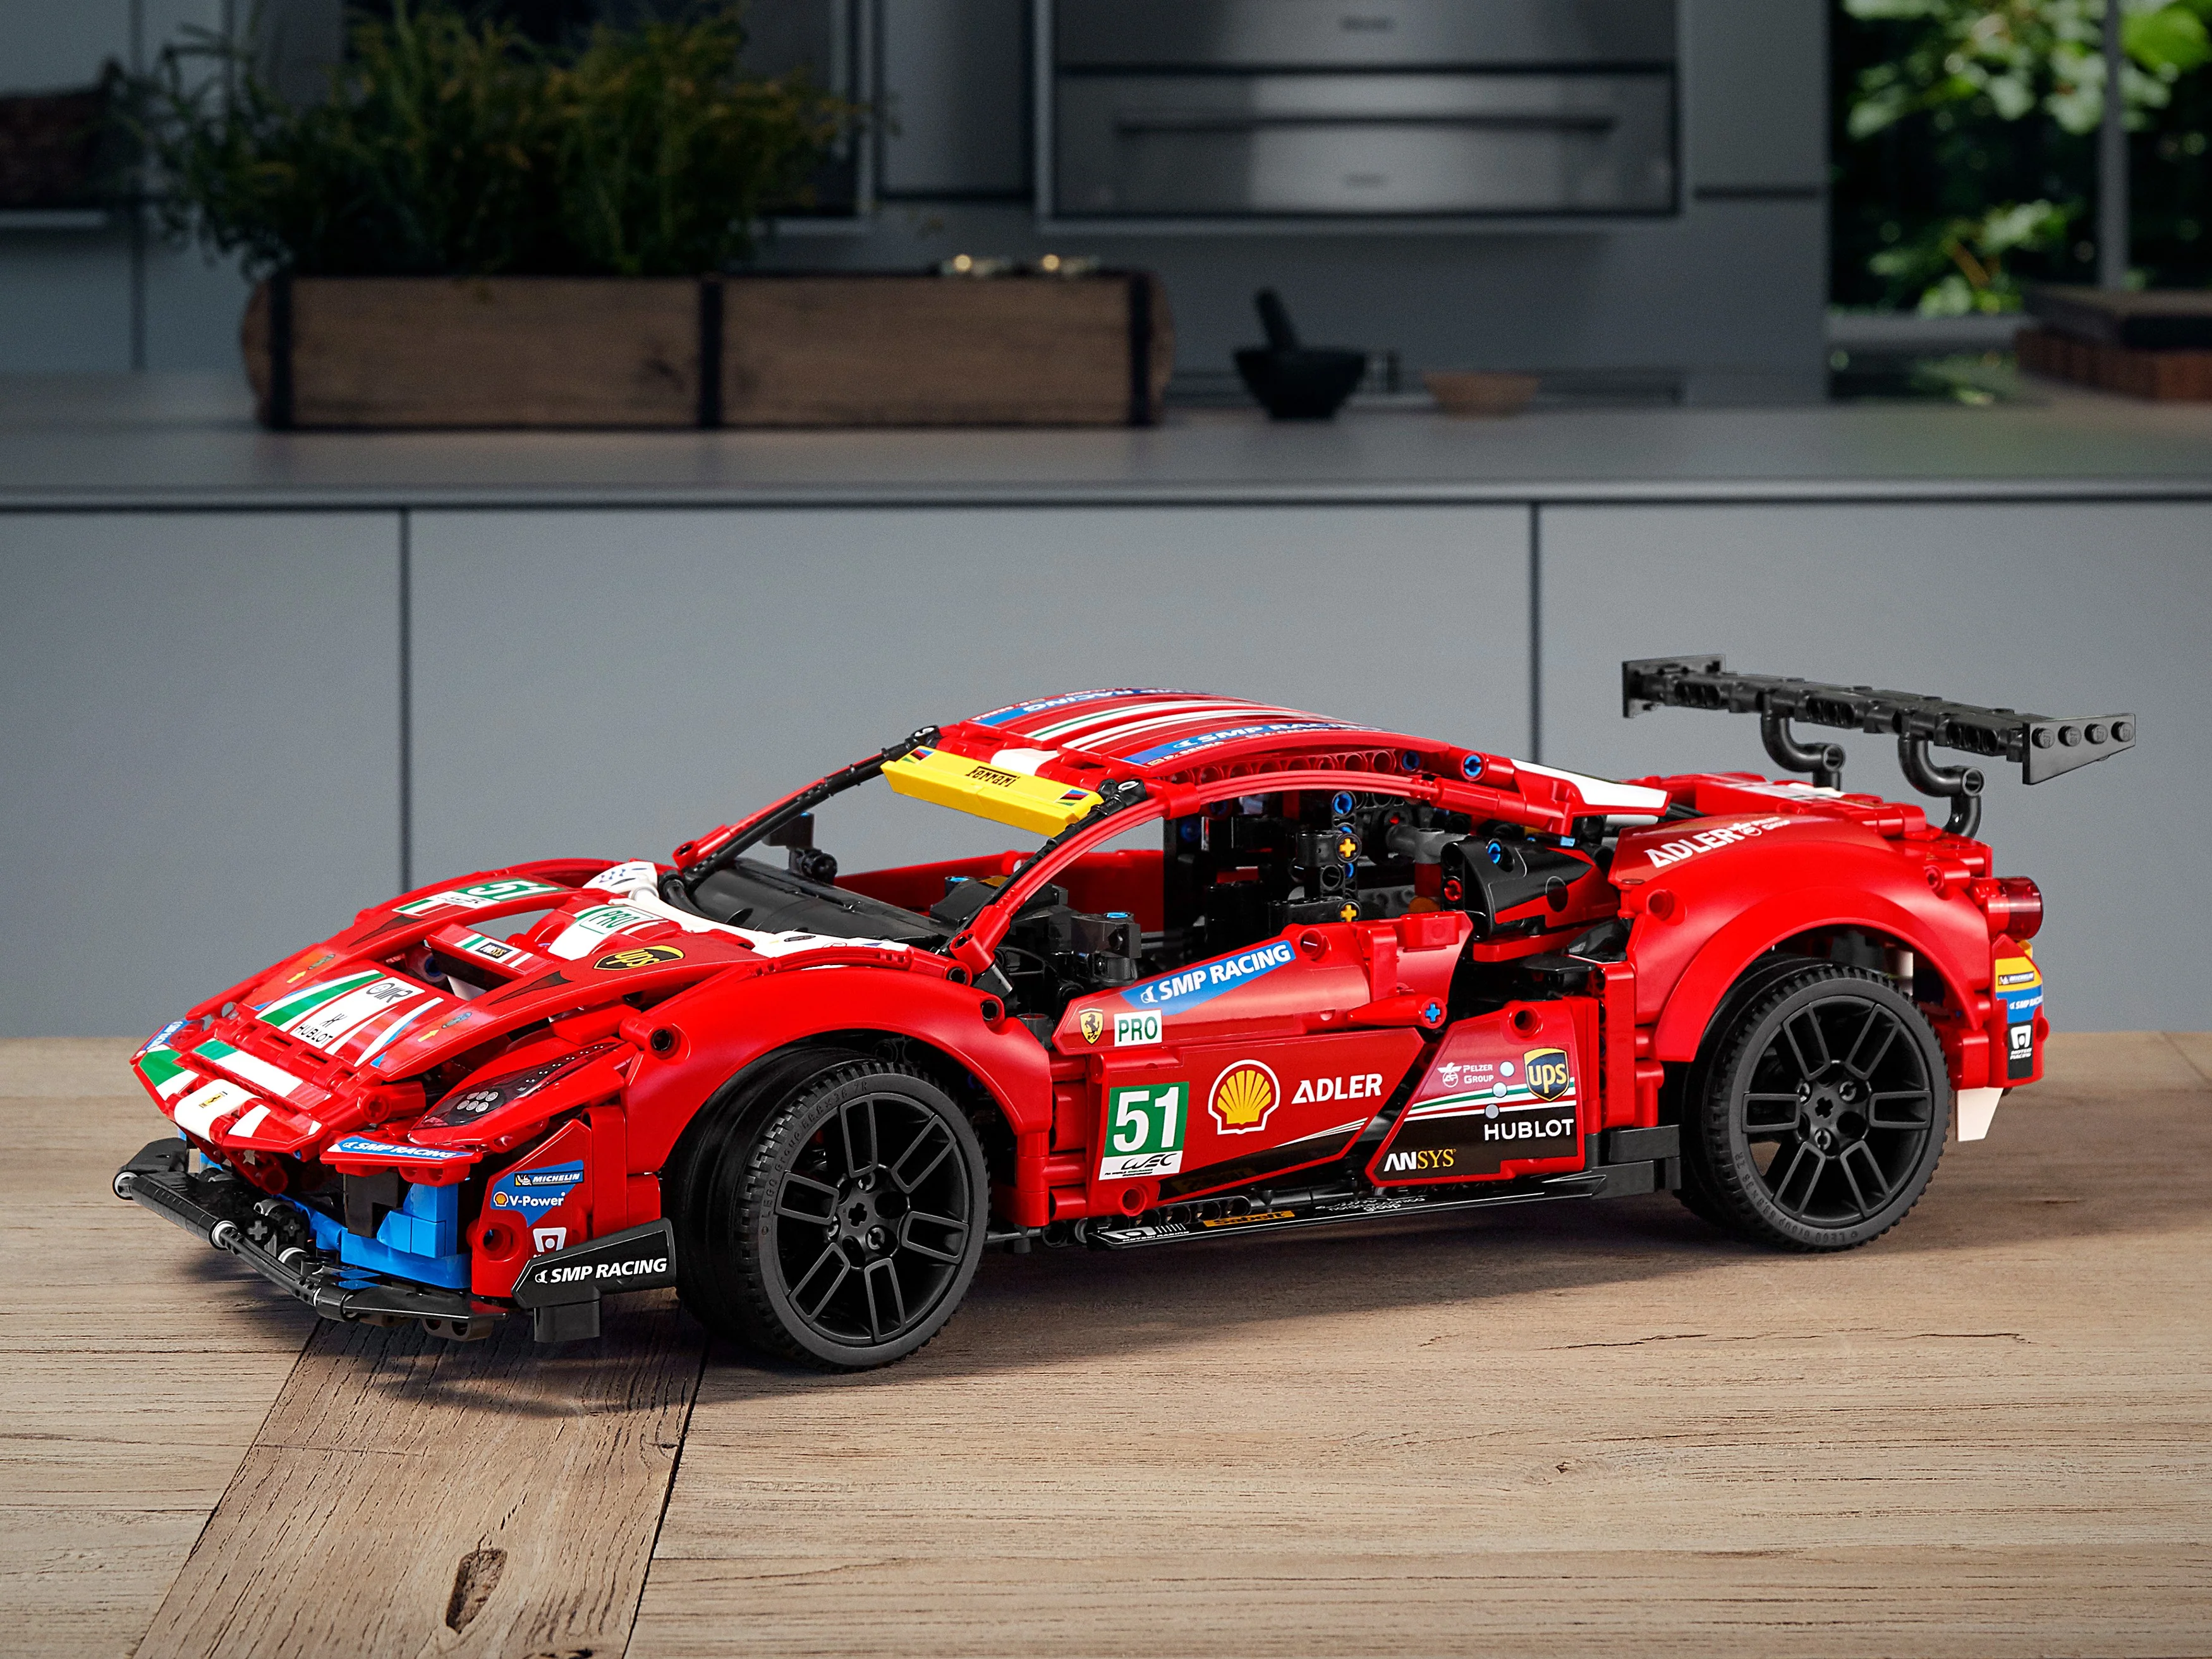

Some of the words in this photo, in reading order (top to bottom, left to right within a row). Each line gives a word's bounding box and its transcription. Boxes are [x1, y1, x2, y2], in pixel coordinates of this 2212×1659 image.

[1198, 726, 1263, 743] SMP
[965, 765, 1021, 788] Ferrari
[1644, 829, 1746, 868] ADLER
[588, 910, 643, 928] PRO
[1159, 970, 1206, 1000] SMP
[1210, 945, 1291, 984] RACING
[295, 1023, 333, 1044] HUBLOT
[1118, 1016, 1157, 1042] PRO
[1463, 1064, 1493, 1073] PELZER
[1464, 1074, 1494, 1084] GROUP
[1528, 1063, 1567, 1093] ups
[1291, 1073, 1382, 1104] ADLER
[1113, 1086, 1179, 1152] 51
[1485, 1119, 1574, 1141] HUBLOT
[353, 1142, 392, 1152] SMP
[391, 1146, 458, 1158] RACING
[1383, 1148, 1454, 1172] ANSYS
[532, 1173, 580, 1183] MICHELIN
[509, 1194, 564, 1206] V-Power
[550, 1265, 592, 1284] SMP
[595, 1258, 667, 1279] RACING
